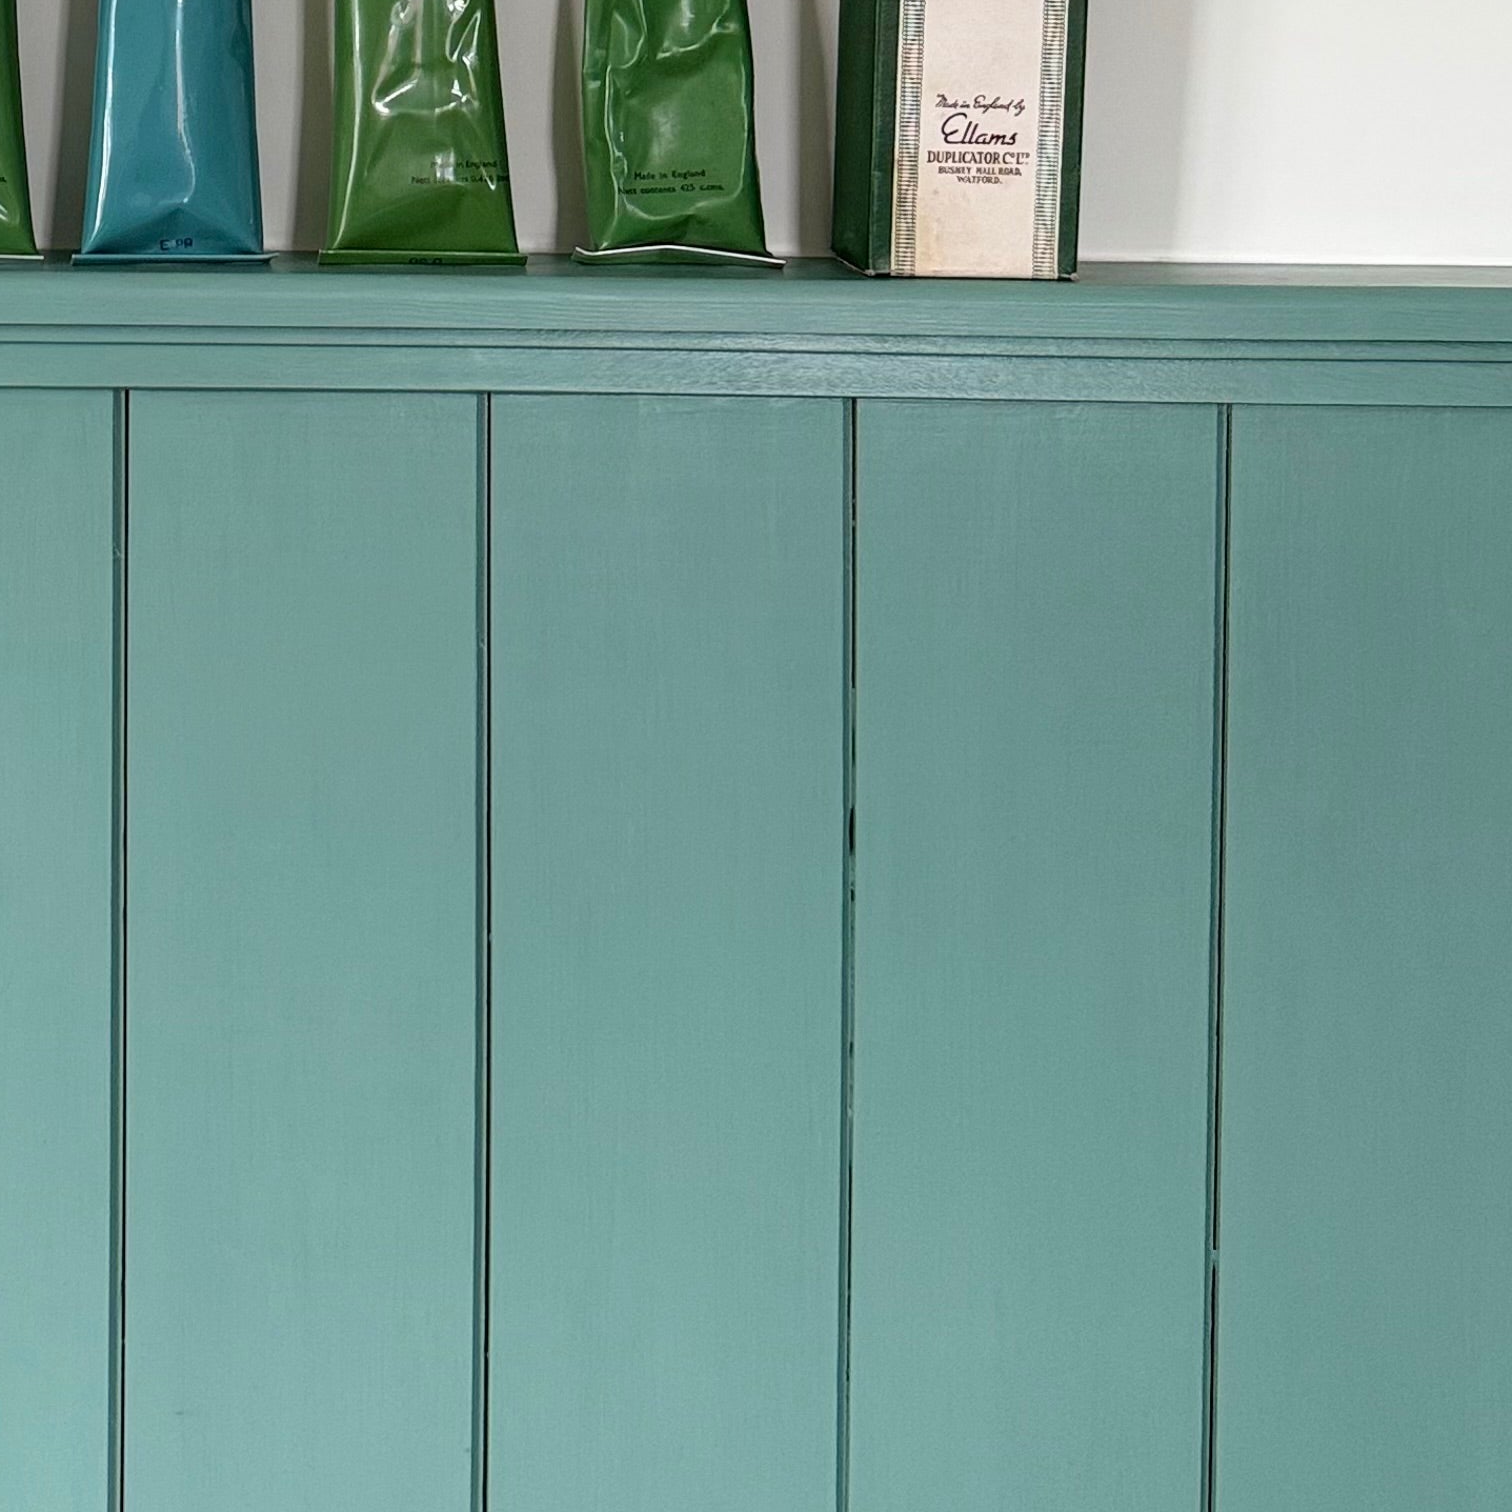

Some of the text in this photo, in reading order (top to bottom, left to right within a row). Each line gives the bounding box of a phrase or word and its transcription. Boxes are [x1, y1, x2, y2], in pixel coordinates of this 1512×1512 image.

[934, 93, 960, 109] Made
[973, 94, 1015, 115] England
[1012, 98, 1026, 117] by
[940, 112, 1019, 146] Ellams
[926, 150, 1001, 165] DUPLICATOR
[634, 170, 657, 181] Made
[671, 169, 707, 180] England
